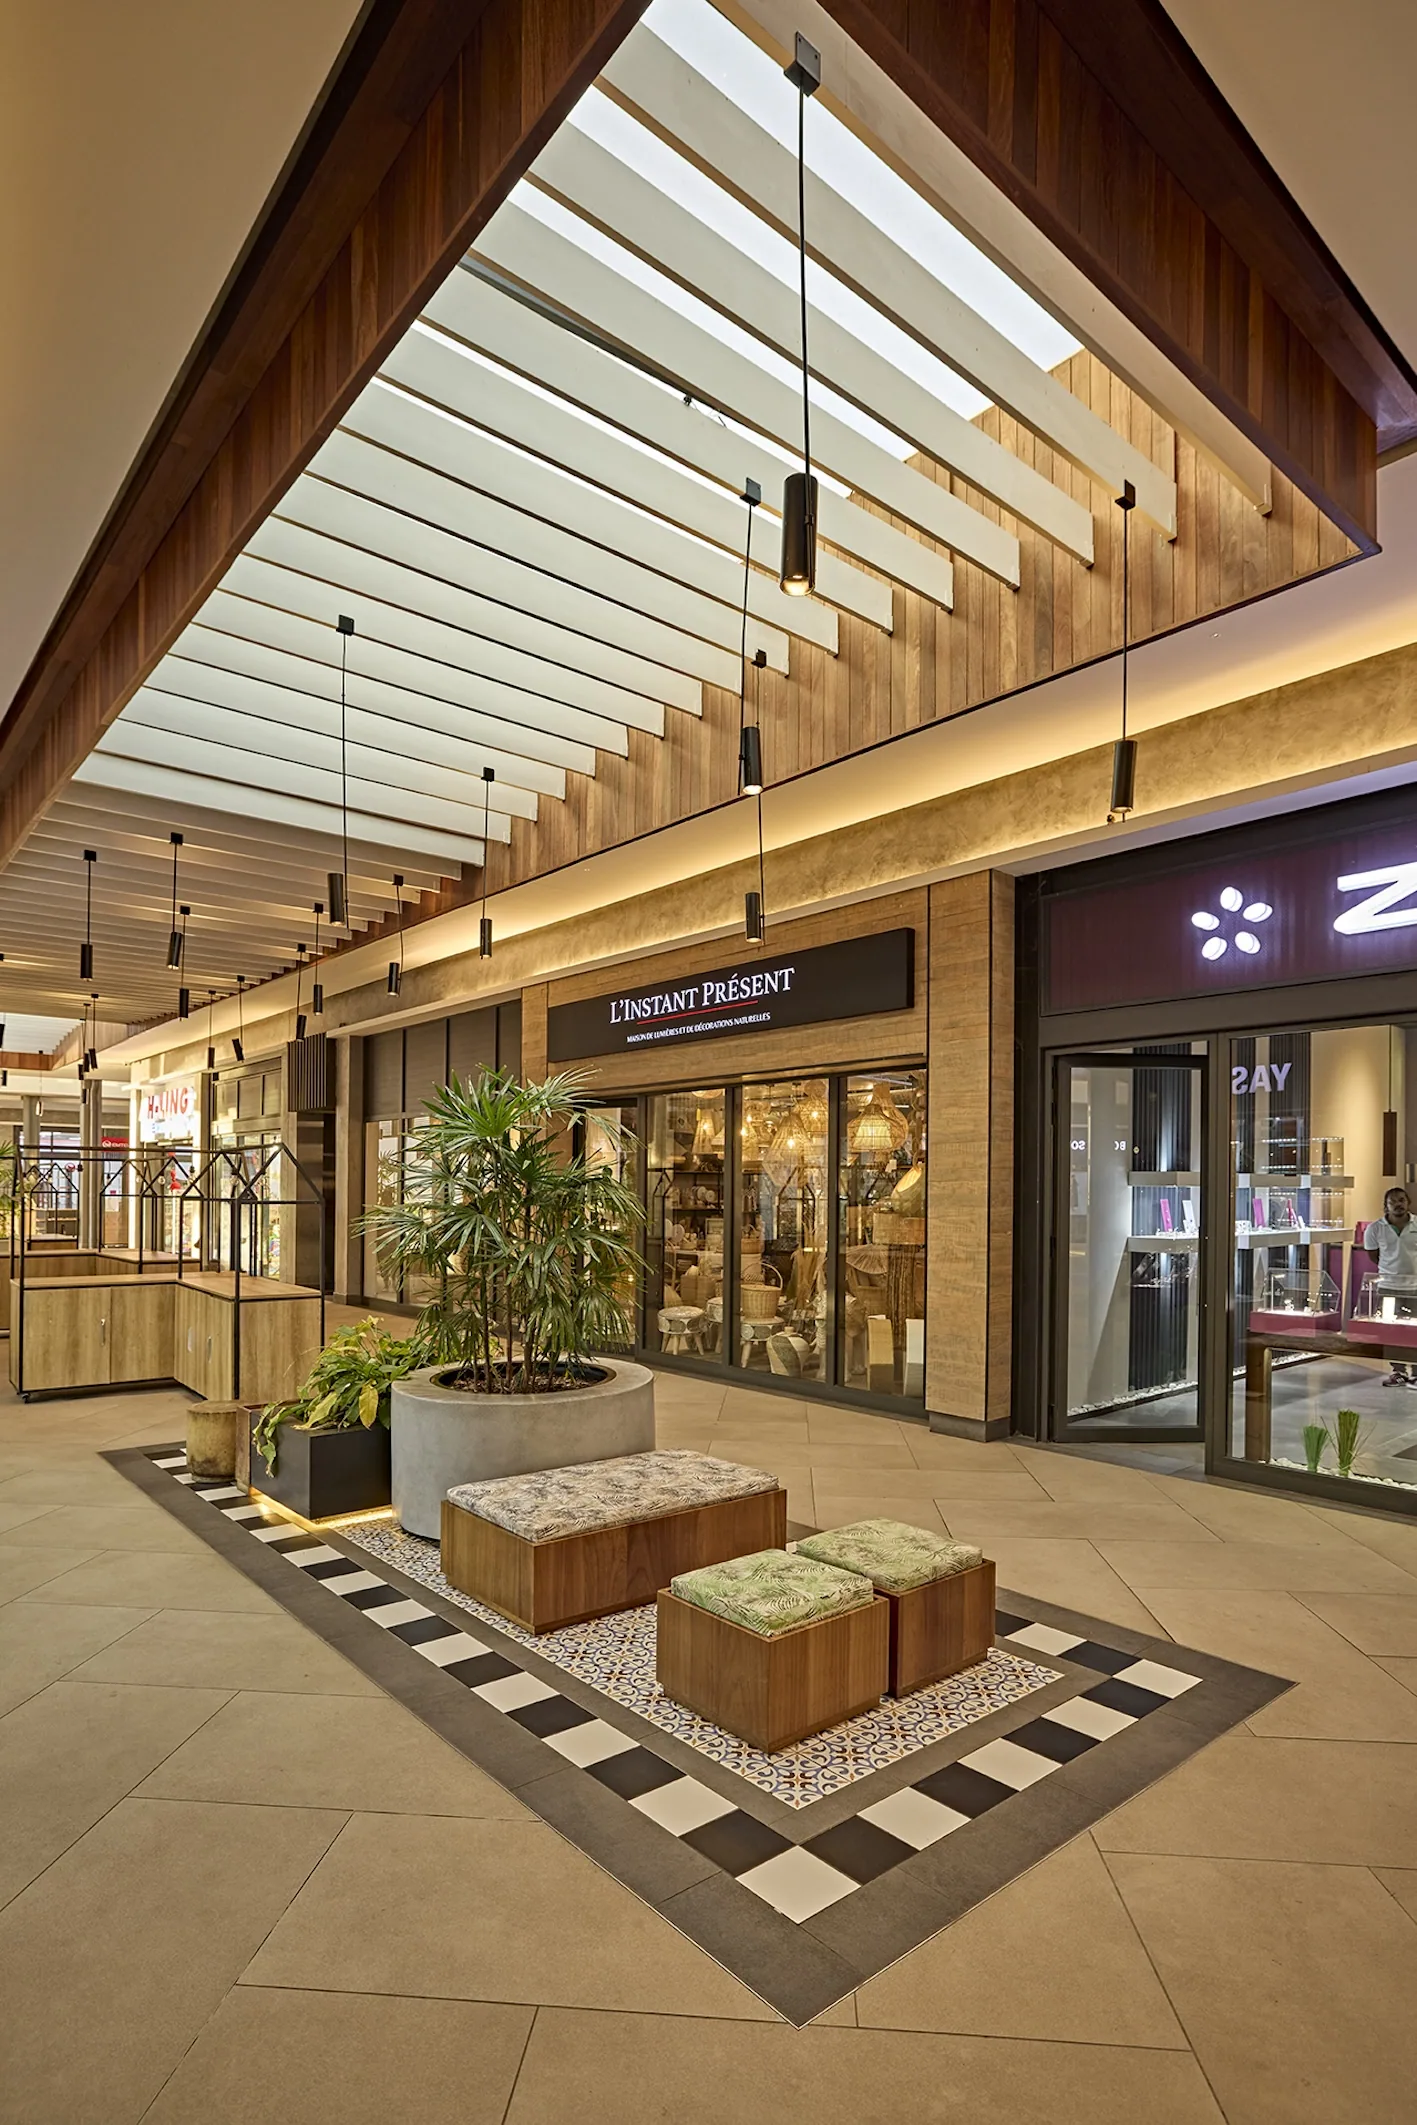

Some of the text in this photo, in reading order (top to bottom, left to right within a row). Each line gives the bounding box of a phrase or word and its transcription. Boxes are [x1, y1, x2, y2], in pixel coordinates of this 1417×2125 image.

[609, 967, 795, 1024] L'INSTANT PRÉSENT
[626, 1012, 771, 1043] MAISON DE LUMIÈRES ET DE DÉCORATIONS NATURELLES
